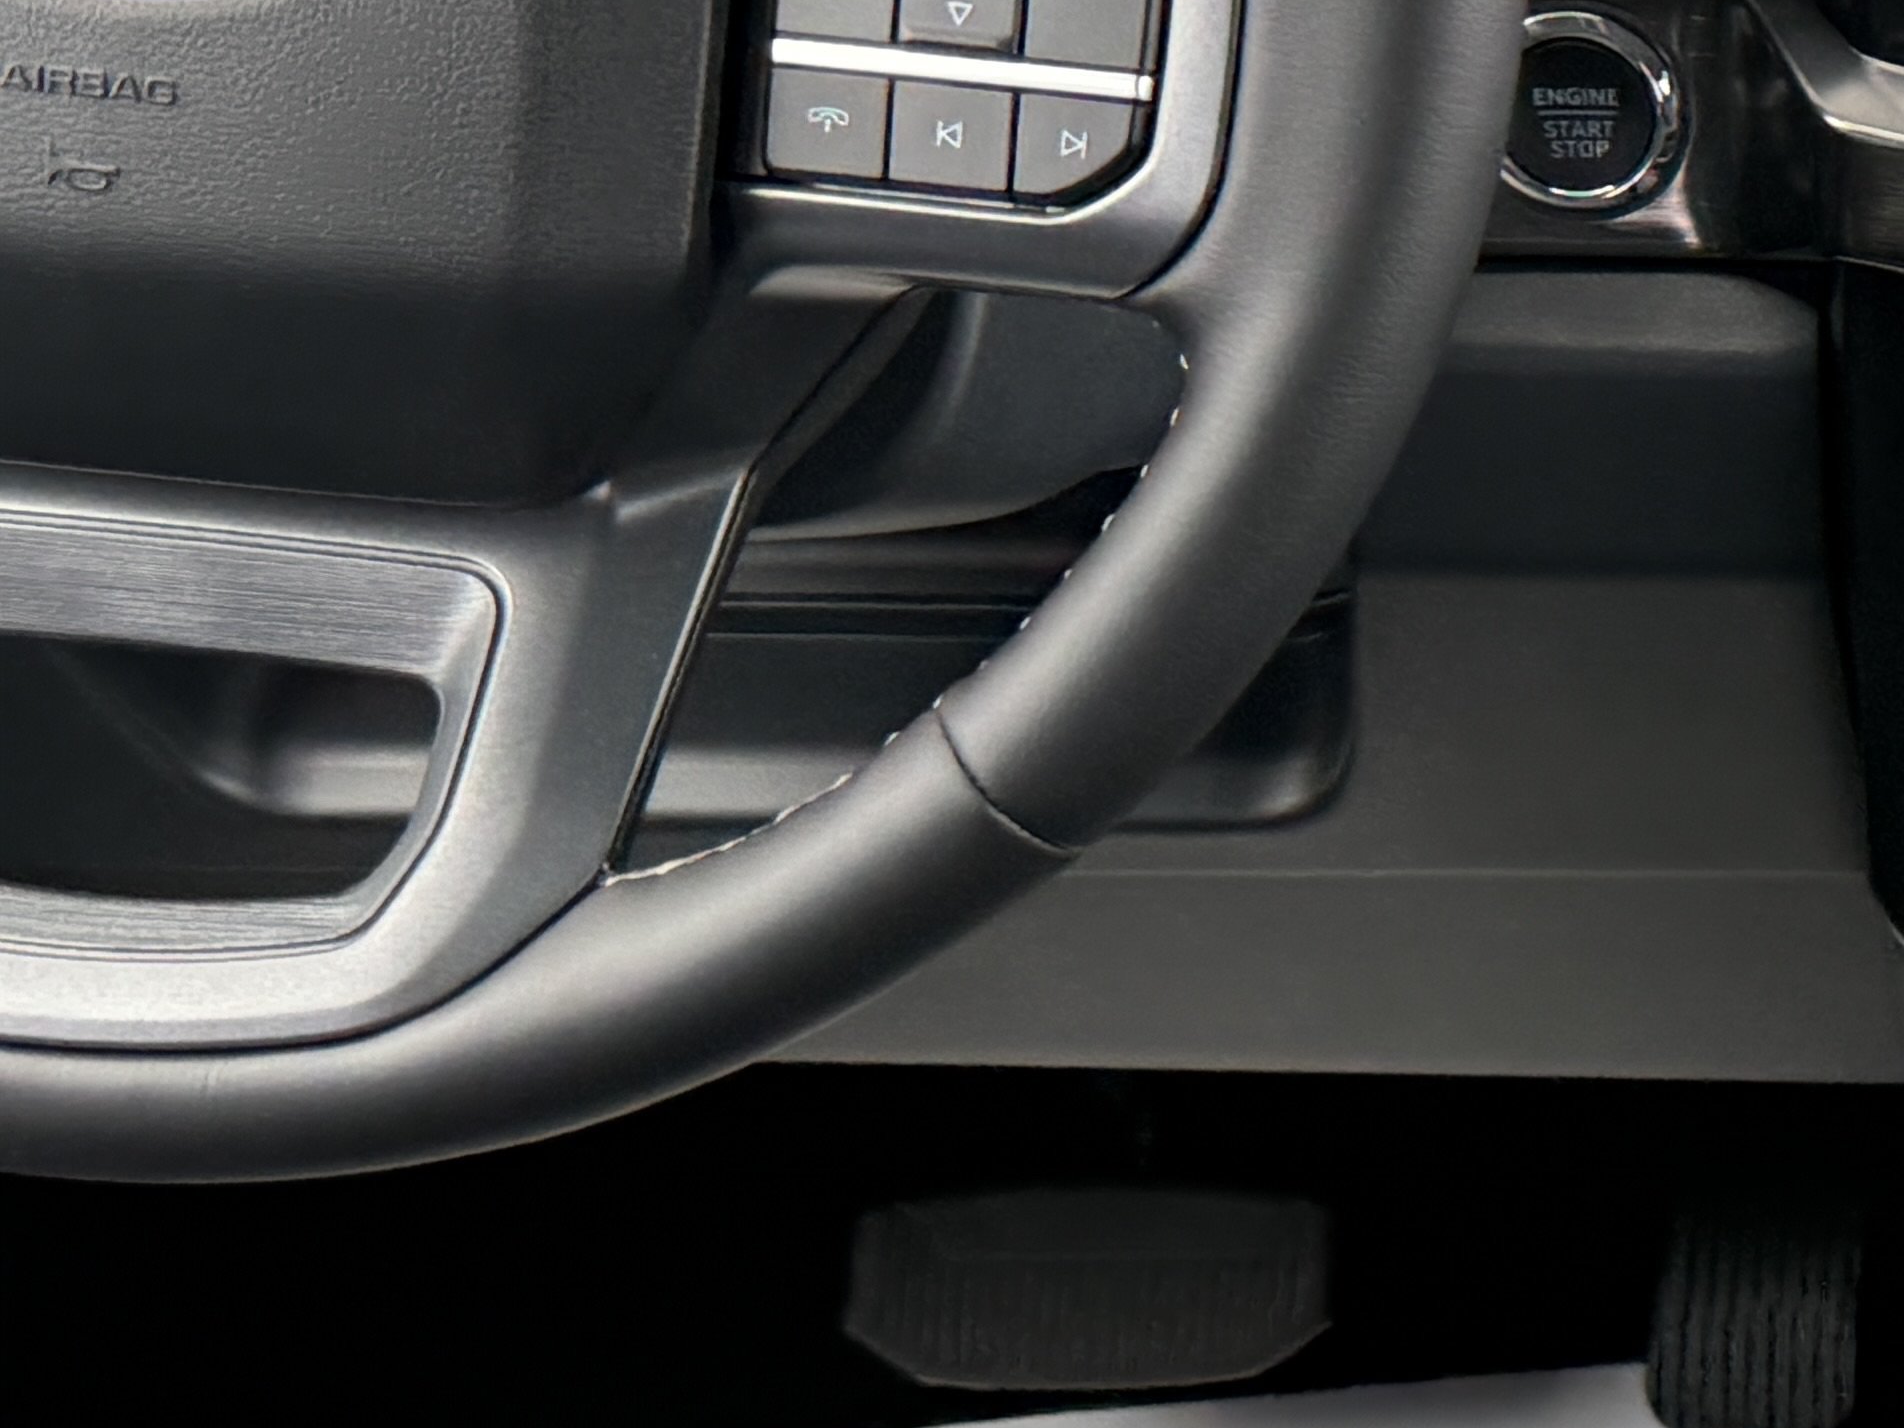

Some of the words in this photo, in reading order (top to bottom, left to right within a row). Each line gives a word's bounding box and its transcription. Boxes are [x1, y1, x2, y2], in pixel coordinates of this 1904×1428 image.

[1, 64, 179, 106] AIRBAG
[1532, 87, 1620, 107] ENGINE
[1543, 120, 1615, 139] START
[1551, 140, 1610, 159] STOP
